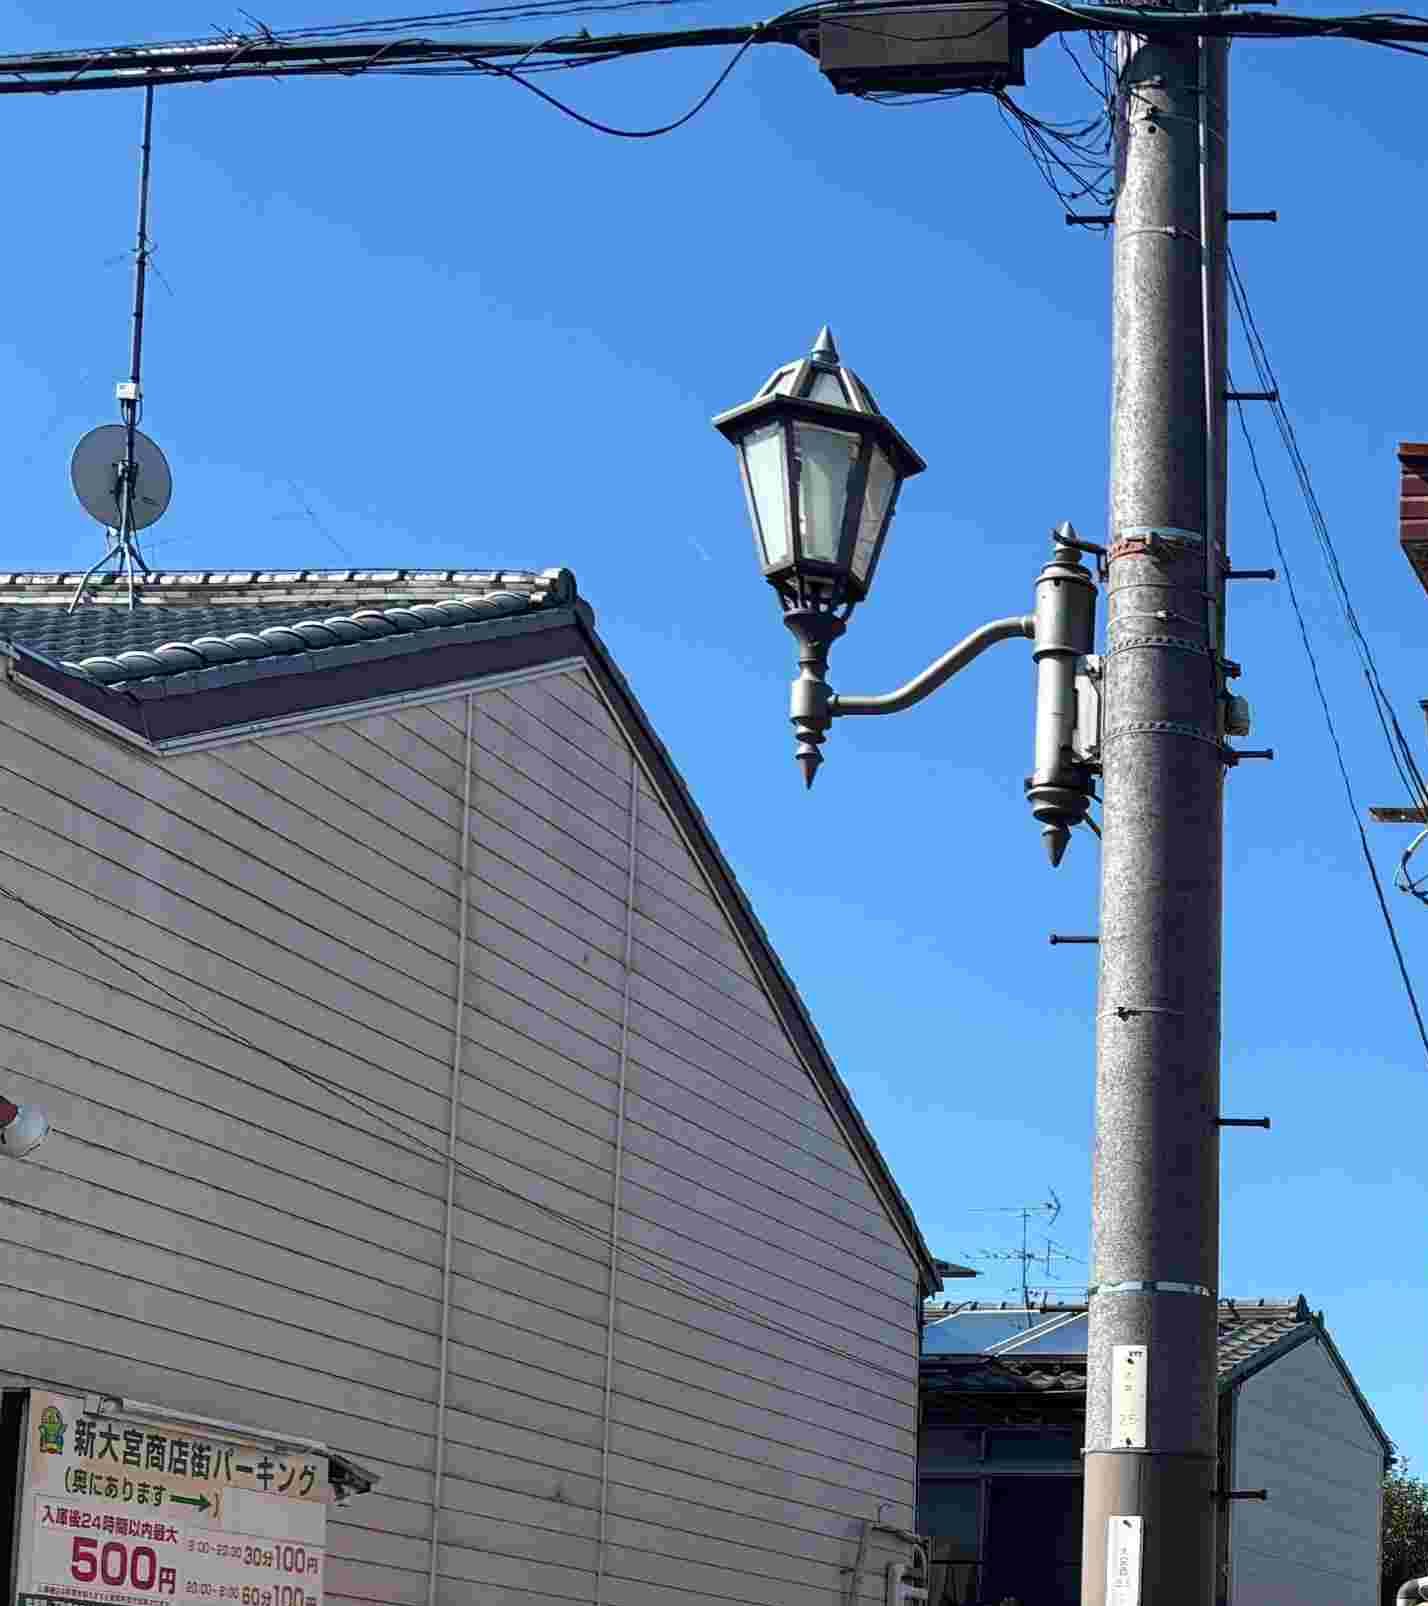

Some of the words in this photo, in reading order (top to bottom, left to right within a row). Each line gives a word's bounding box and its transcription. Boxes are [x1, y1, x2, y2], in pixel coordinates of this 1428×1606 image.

[73, 1418, 317, 1497] 新大宮商店街パーキング
[71, 1535, 178, 1595] 500円
